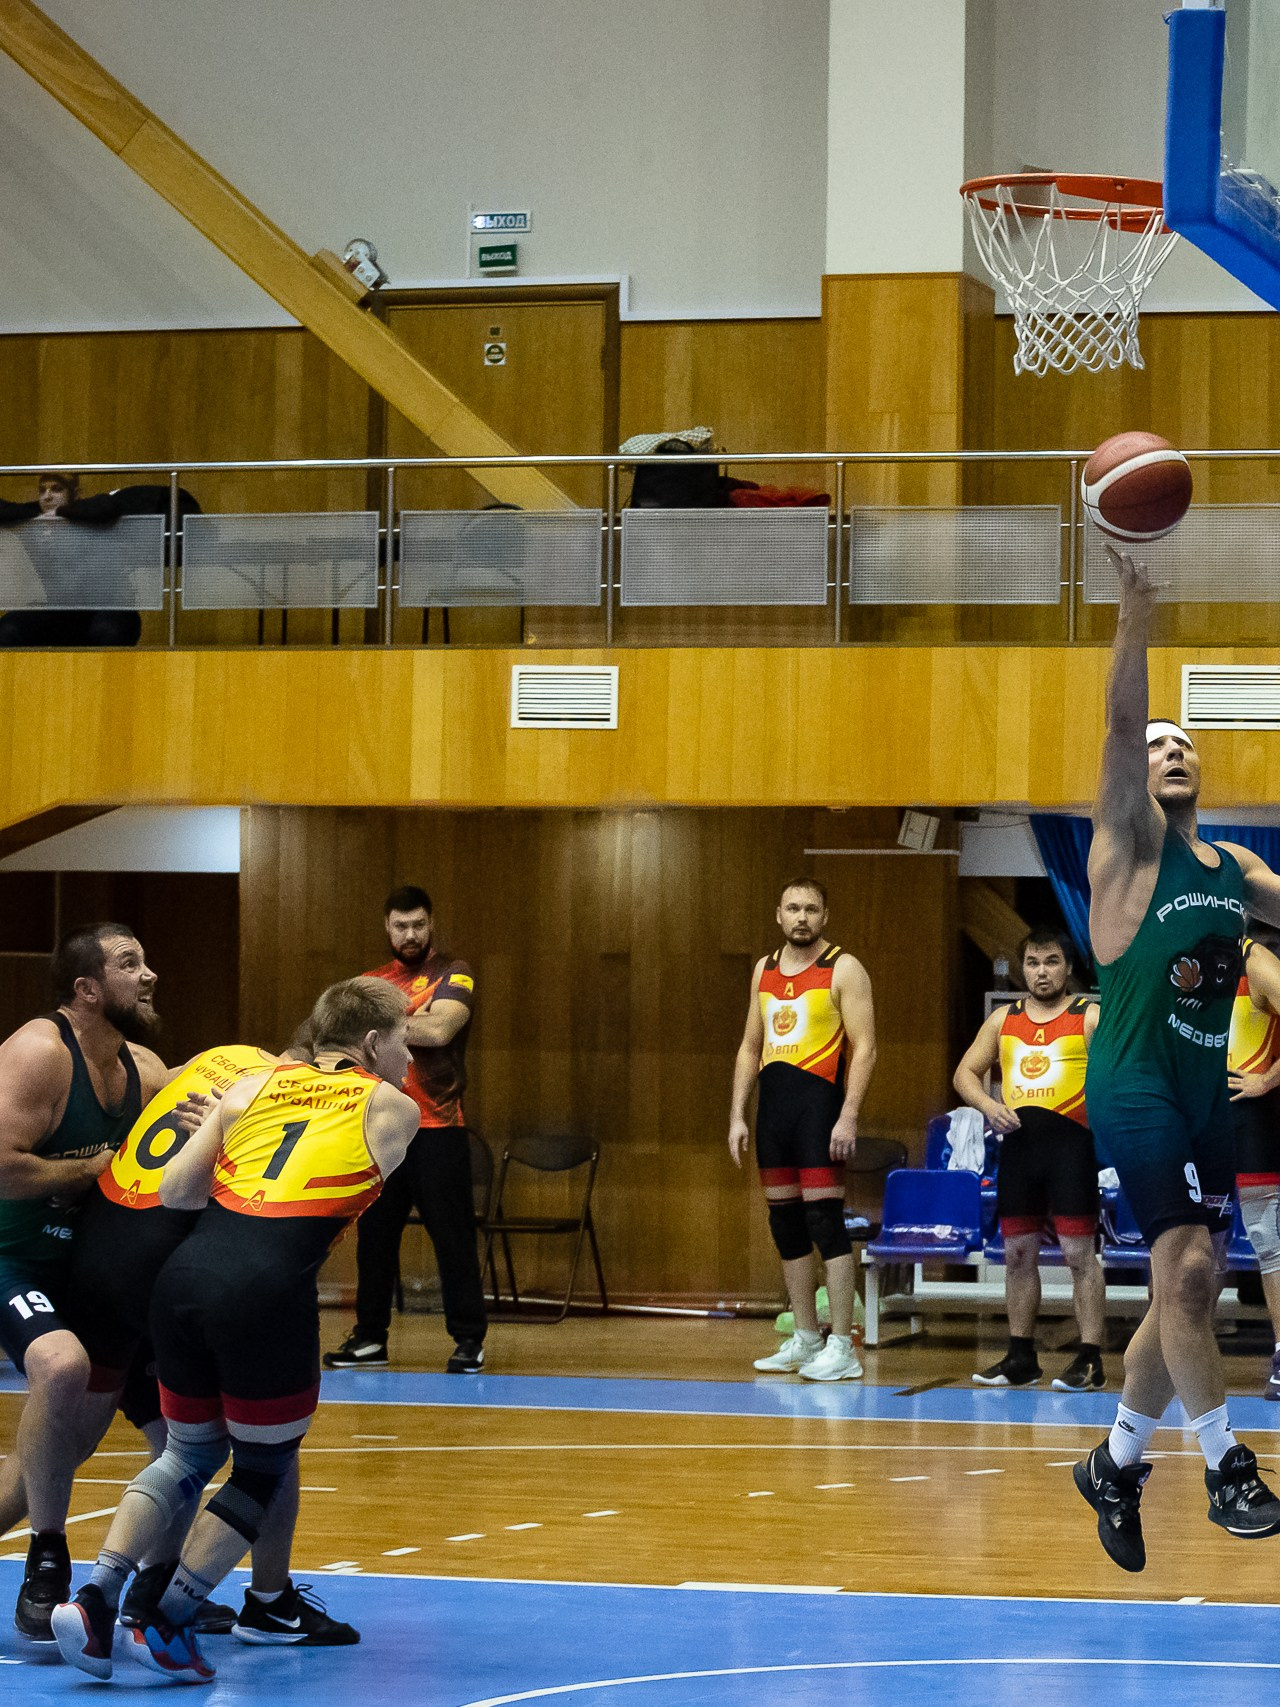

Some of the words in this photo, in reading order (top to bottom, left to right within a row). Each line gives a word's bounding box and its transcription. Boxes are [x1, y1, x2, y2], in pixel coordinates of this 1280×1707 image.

[474, 215, 526, 228] ЫХОД
[1167, 1013, 1228, 1048] МЕДВЕ
[195, 1065, 235, 1091] ЧУВАШ
[1027, 1087, 1055, 1098] ВПП
[262, 1119, 311, 1180] 1
[1183, 1162, 1202, 1203] 9
[8, 1290, 55, 1320] 19
